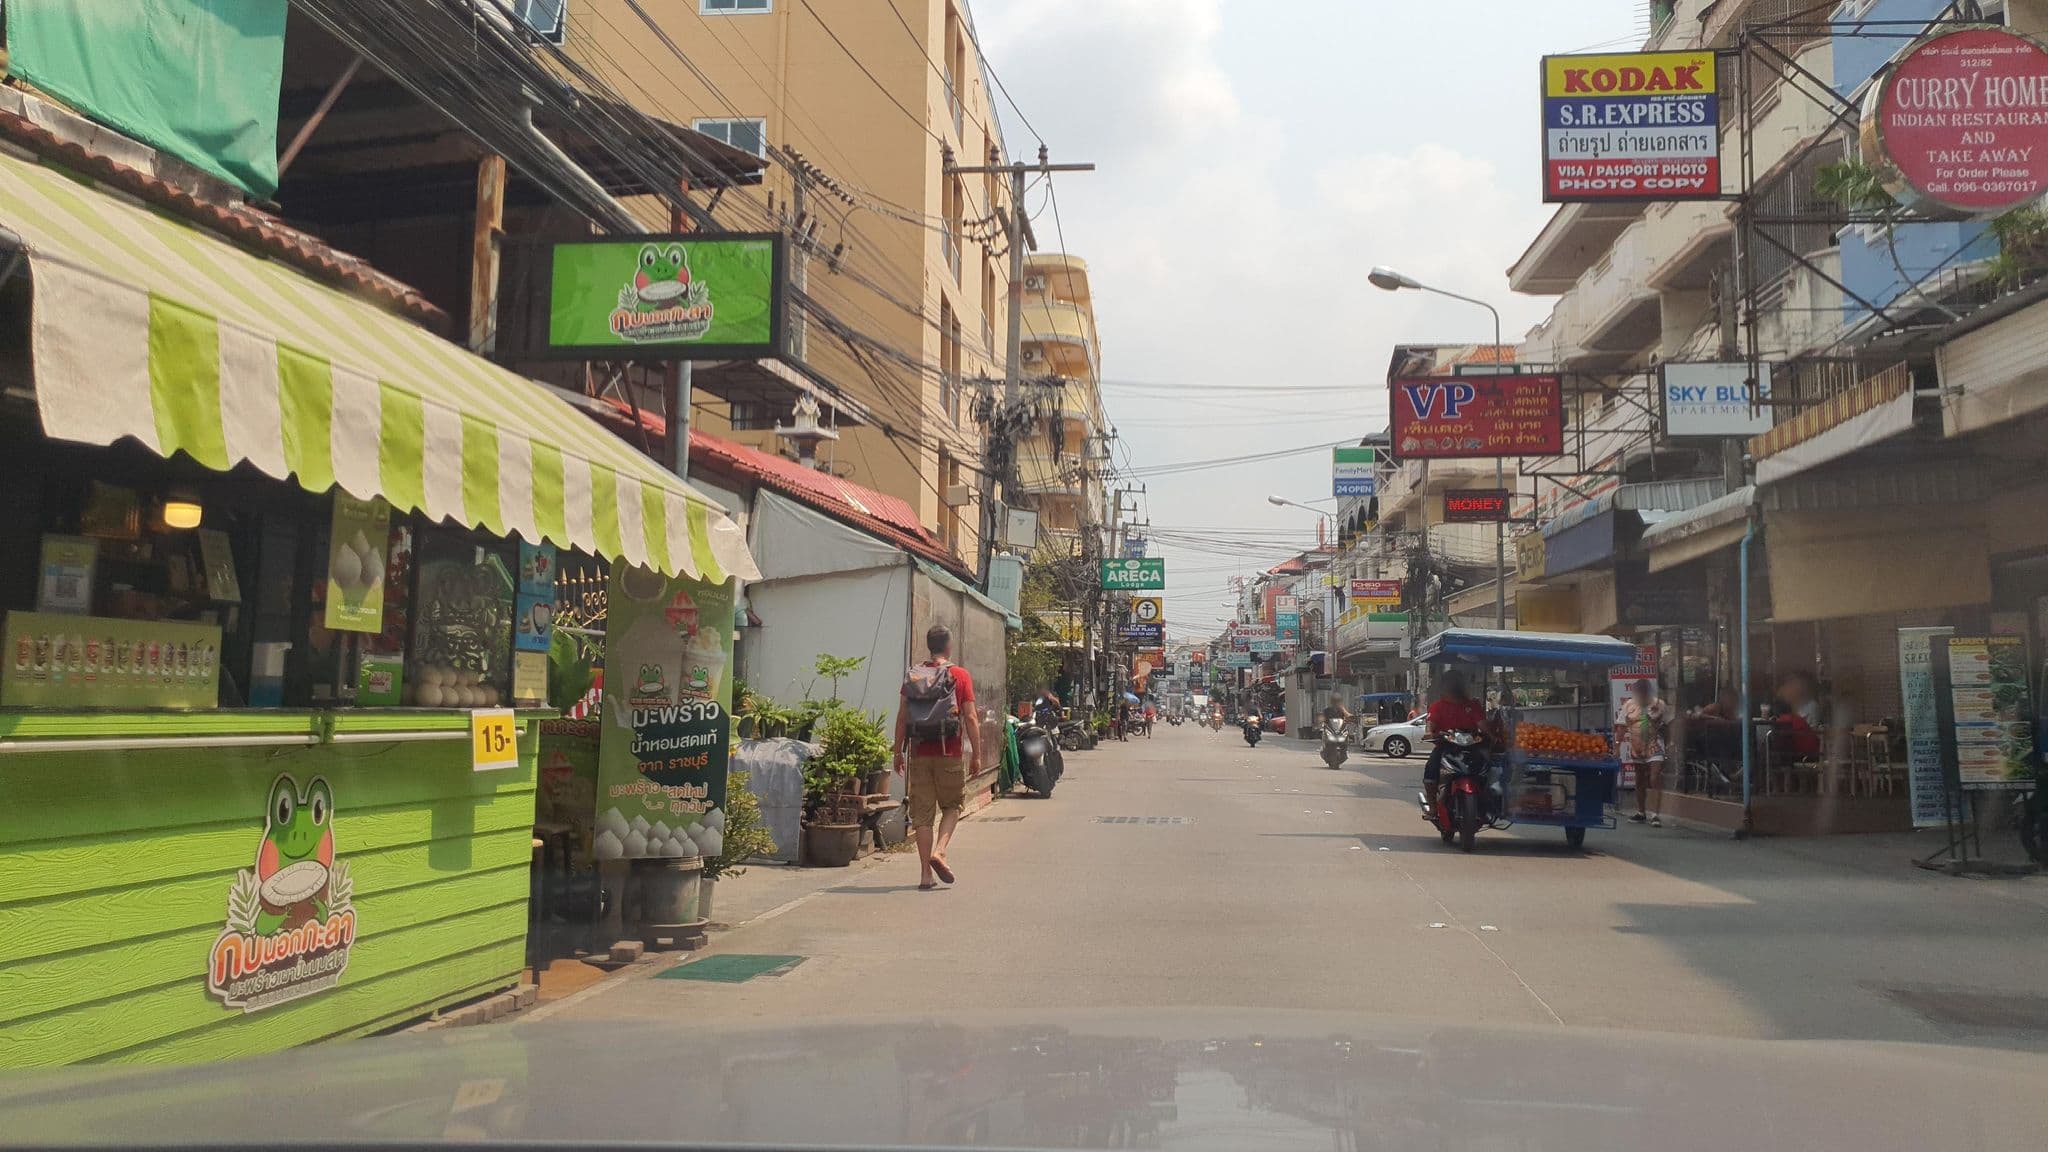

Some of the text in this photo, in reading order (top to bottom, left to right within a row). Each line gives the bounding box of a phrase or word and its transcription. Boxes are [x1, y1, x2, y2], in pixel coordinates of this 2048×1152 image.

[1960, 59, 1993, 68] 312/82
[1563, 65, 1704, 93] KODAK
[1896, 71, 1981, 110] CURRY
[1560, 101, 1706, 126] S.R.EXPRESS
[1892, 113, 1947, 127] INDIAN
[1558, 129, 1708, 158] ถ่ายรูป ถ่ายเอกสาร
[1960, 131, 1996, 145] AND
[1926, 146, 2033, 164] TAKE AWAY
[1558, 165, 1586, 177] VISA
[1596, 164, 1659, 176] PASSPORT
[1662, 163, 1708, 175] PHOTO
[1936, 167, 2030, 179] For Order Please
[1558, 177, 1705, 190] PHOTO COPY
[1401, 381, 1475, 419] VP
[1669, 385, 1708, 402] SKY
[1336, 485, 1372, 494] 24 OPEN
[1447, 497, 1504, 511] MONEY
[1106, 569, 1161, 582] ARECA
[633, 698, 720, 728] มะพร้าว
[631, 729, 718, 754] น้ำหอมสดแท้
[639, 751, 709, 773] จาก ราชบุรี
[609, 779, 660, 798] มะพร้าว
[215, 911, 354, 986] กบนอกกะลา
